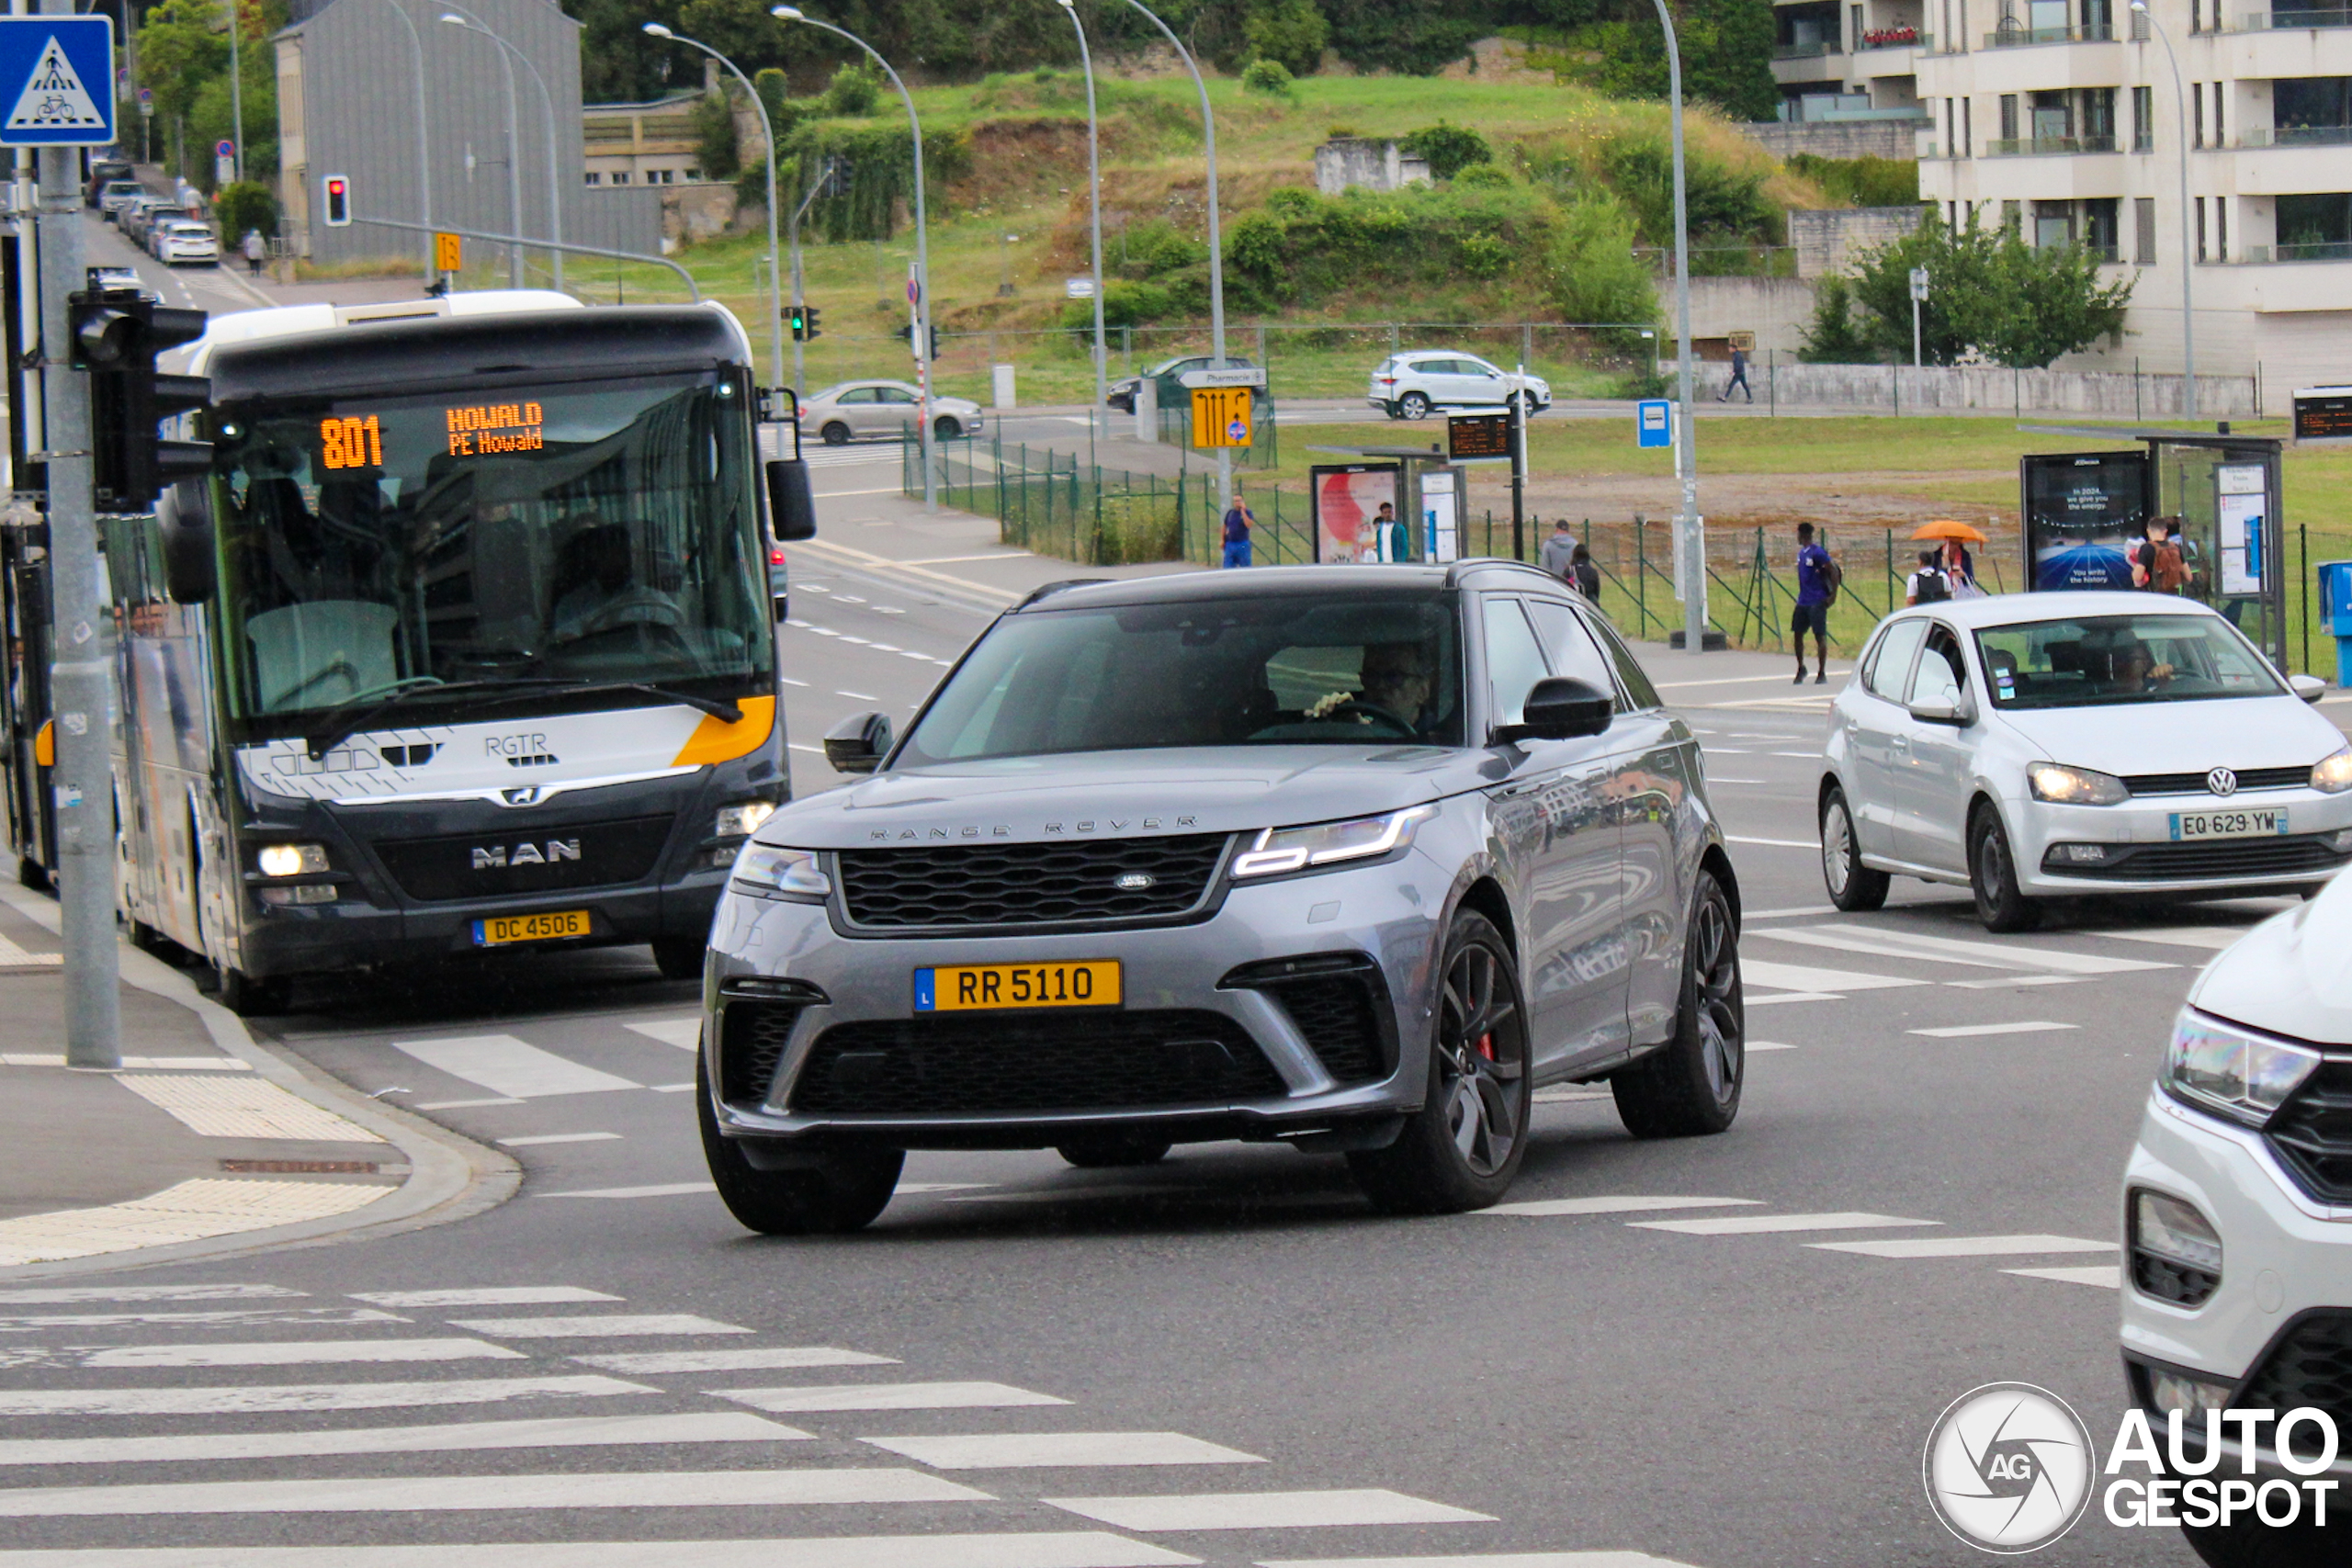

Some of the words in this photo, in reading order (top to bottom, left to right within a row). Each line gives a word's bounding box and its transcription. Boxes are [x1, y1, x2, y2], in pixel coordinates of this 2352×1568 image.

[1206, 372, 1250, 384] Pharmacie
[447, 401, 543, 433] HOWALD
[321, 414, 383, 469] 801
[448, 433, 474, 457] PE
[477, 426, 543, 454] Howald
[2073, 488, 2081, 496] In
[2078, 495, 2094, 504] give
[2095, 495, 2109, 503] you
[485, 732, 548, 758] RGTR
[870, 825, 1012, 841] RANGE
[1045, 816, 1198, 834] ROVER
[471, 838, 582, 870] MAN
[494, 919, 521, 940] DC
[526, 914, 579, 936] 4506
[922, 992, 930, 1005] L
[958, 971, 1001, 1004] RR
[1012, 967, 1092, 1002] 5110
